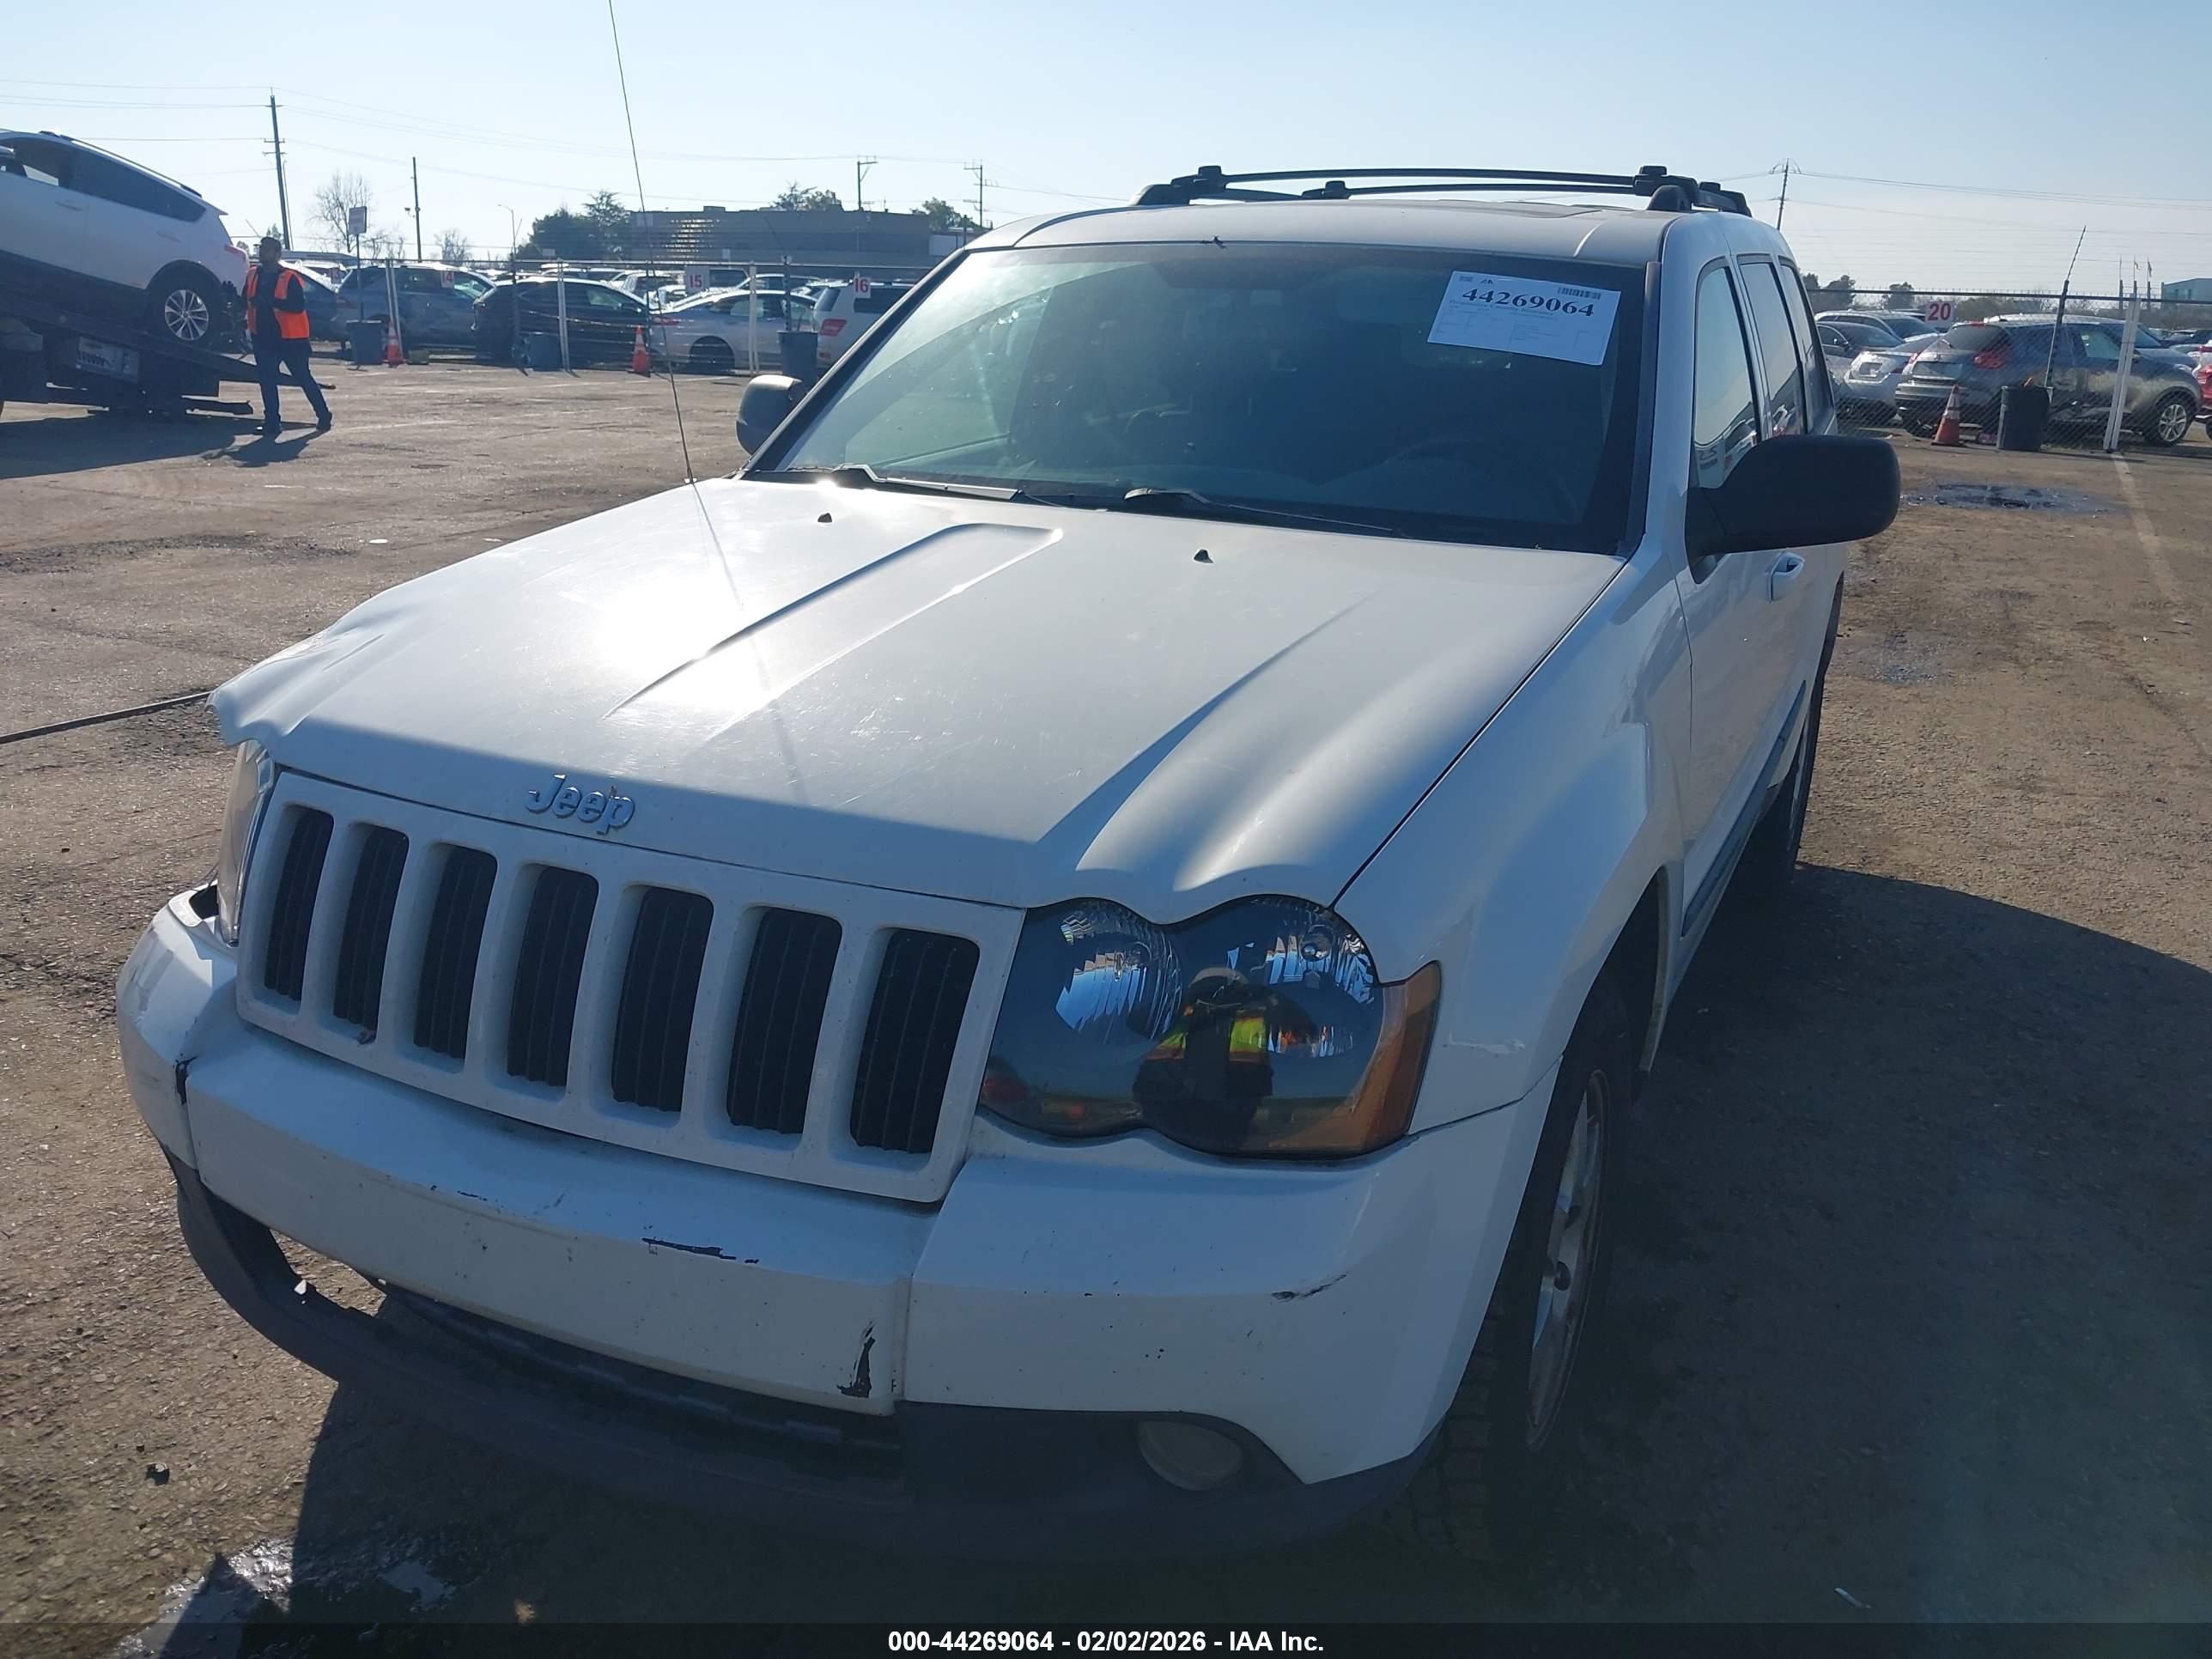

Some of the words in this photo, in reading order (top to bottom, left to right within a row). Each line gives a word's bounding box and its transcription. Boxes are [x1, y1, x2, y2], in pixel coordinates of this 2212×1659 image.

[690, 274, 702, 289] 15
[854, 278, 868, 293] 16
[1462, 288, 1594, 317] 44269064
[1928, 302, 1952, 321] 20
[525, 773, 635, 836] Jeep
